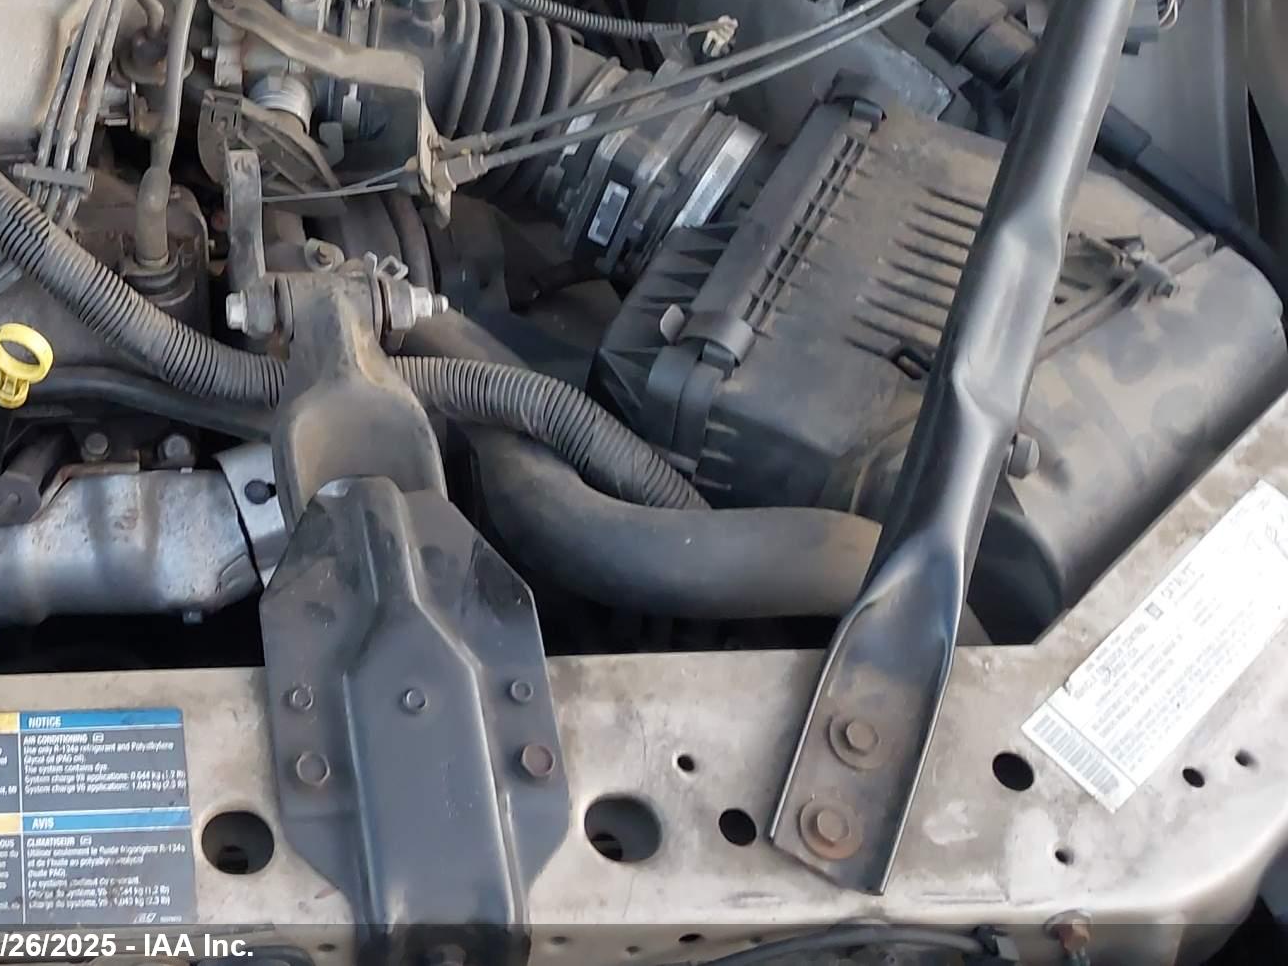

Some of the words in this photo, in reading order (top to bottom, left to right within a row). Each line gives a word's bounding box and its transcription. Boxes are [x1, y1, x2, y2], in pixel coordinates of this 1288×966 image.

[28, 716, 62, 729] NOTICE
[117, 741, 130, 752] and
[32, 817, 54, 830] AVIS
